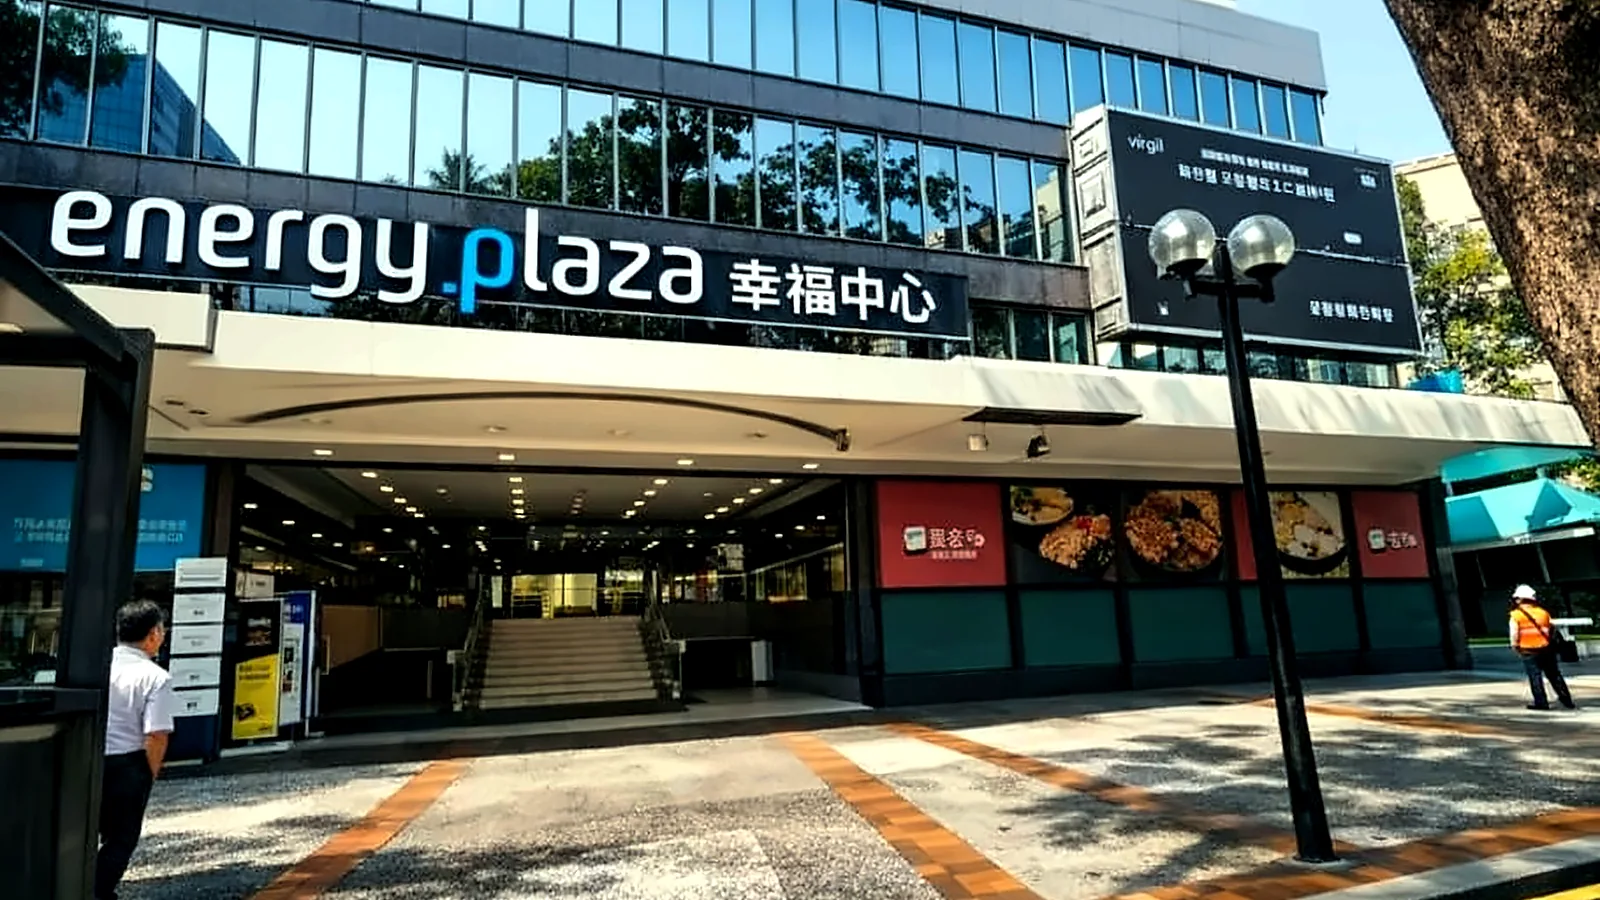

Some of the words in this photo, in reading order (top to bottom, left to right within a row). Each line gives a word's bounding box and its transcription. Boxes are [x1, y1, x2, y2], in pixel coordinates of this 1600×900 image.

[1127, 133, 1165, 155] virgil
[729, 257, 938, 325] 幸福中心
